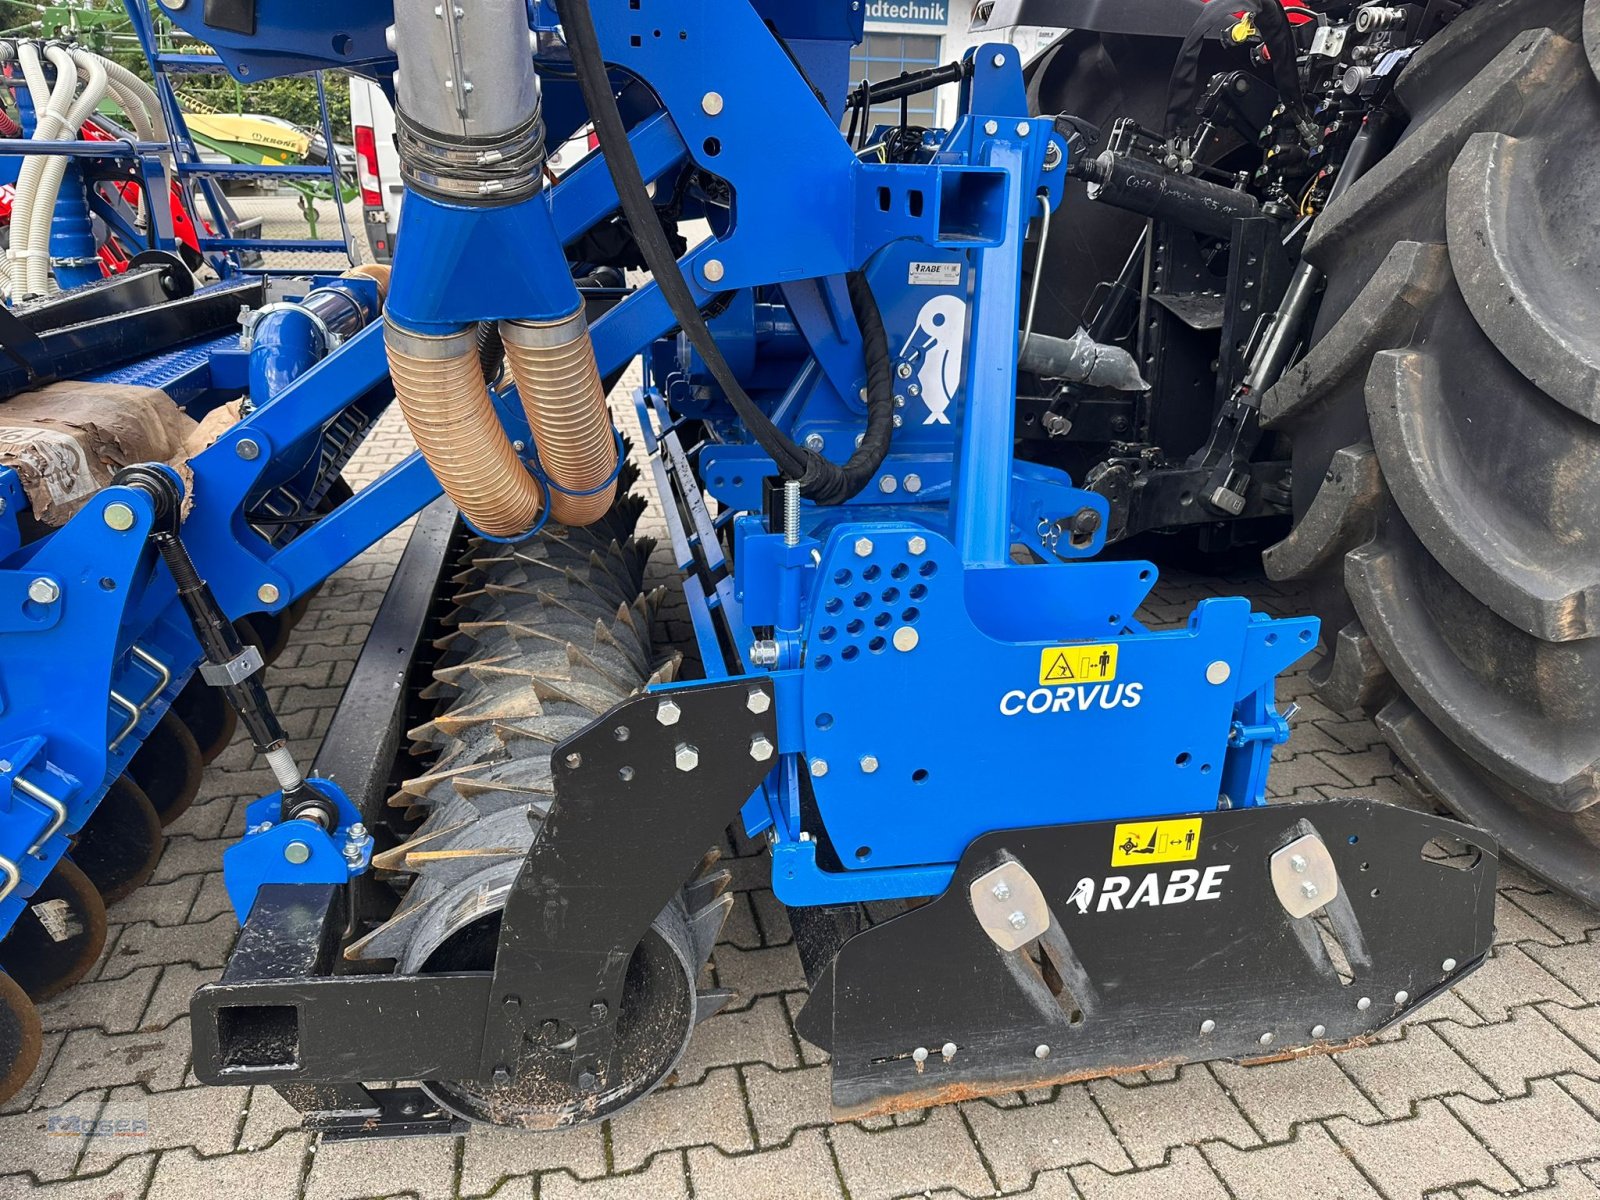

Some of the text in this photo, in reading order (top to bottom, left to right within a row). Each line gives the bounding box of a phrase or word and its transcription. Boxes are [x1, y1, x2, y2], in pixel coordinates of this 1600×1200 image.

[262, 136, 297, 148] KRONE
[920, 265, 941, 273] RABE
[1000, 682, 1143, 716] CORVUS
[1096, 864, 1231, 913] RABE
